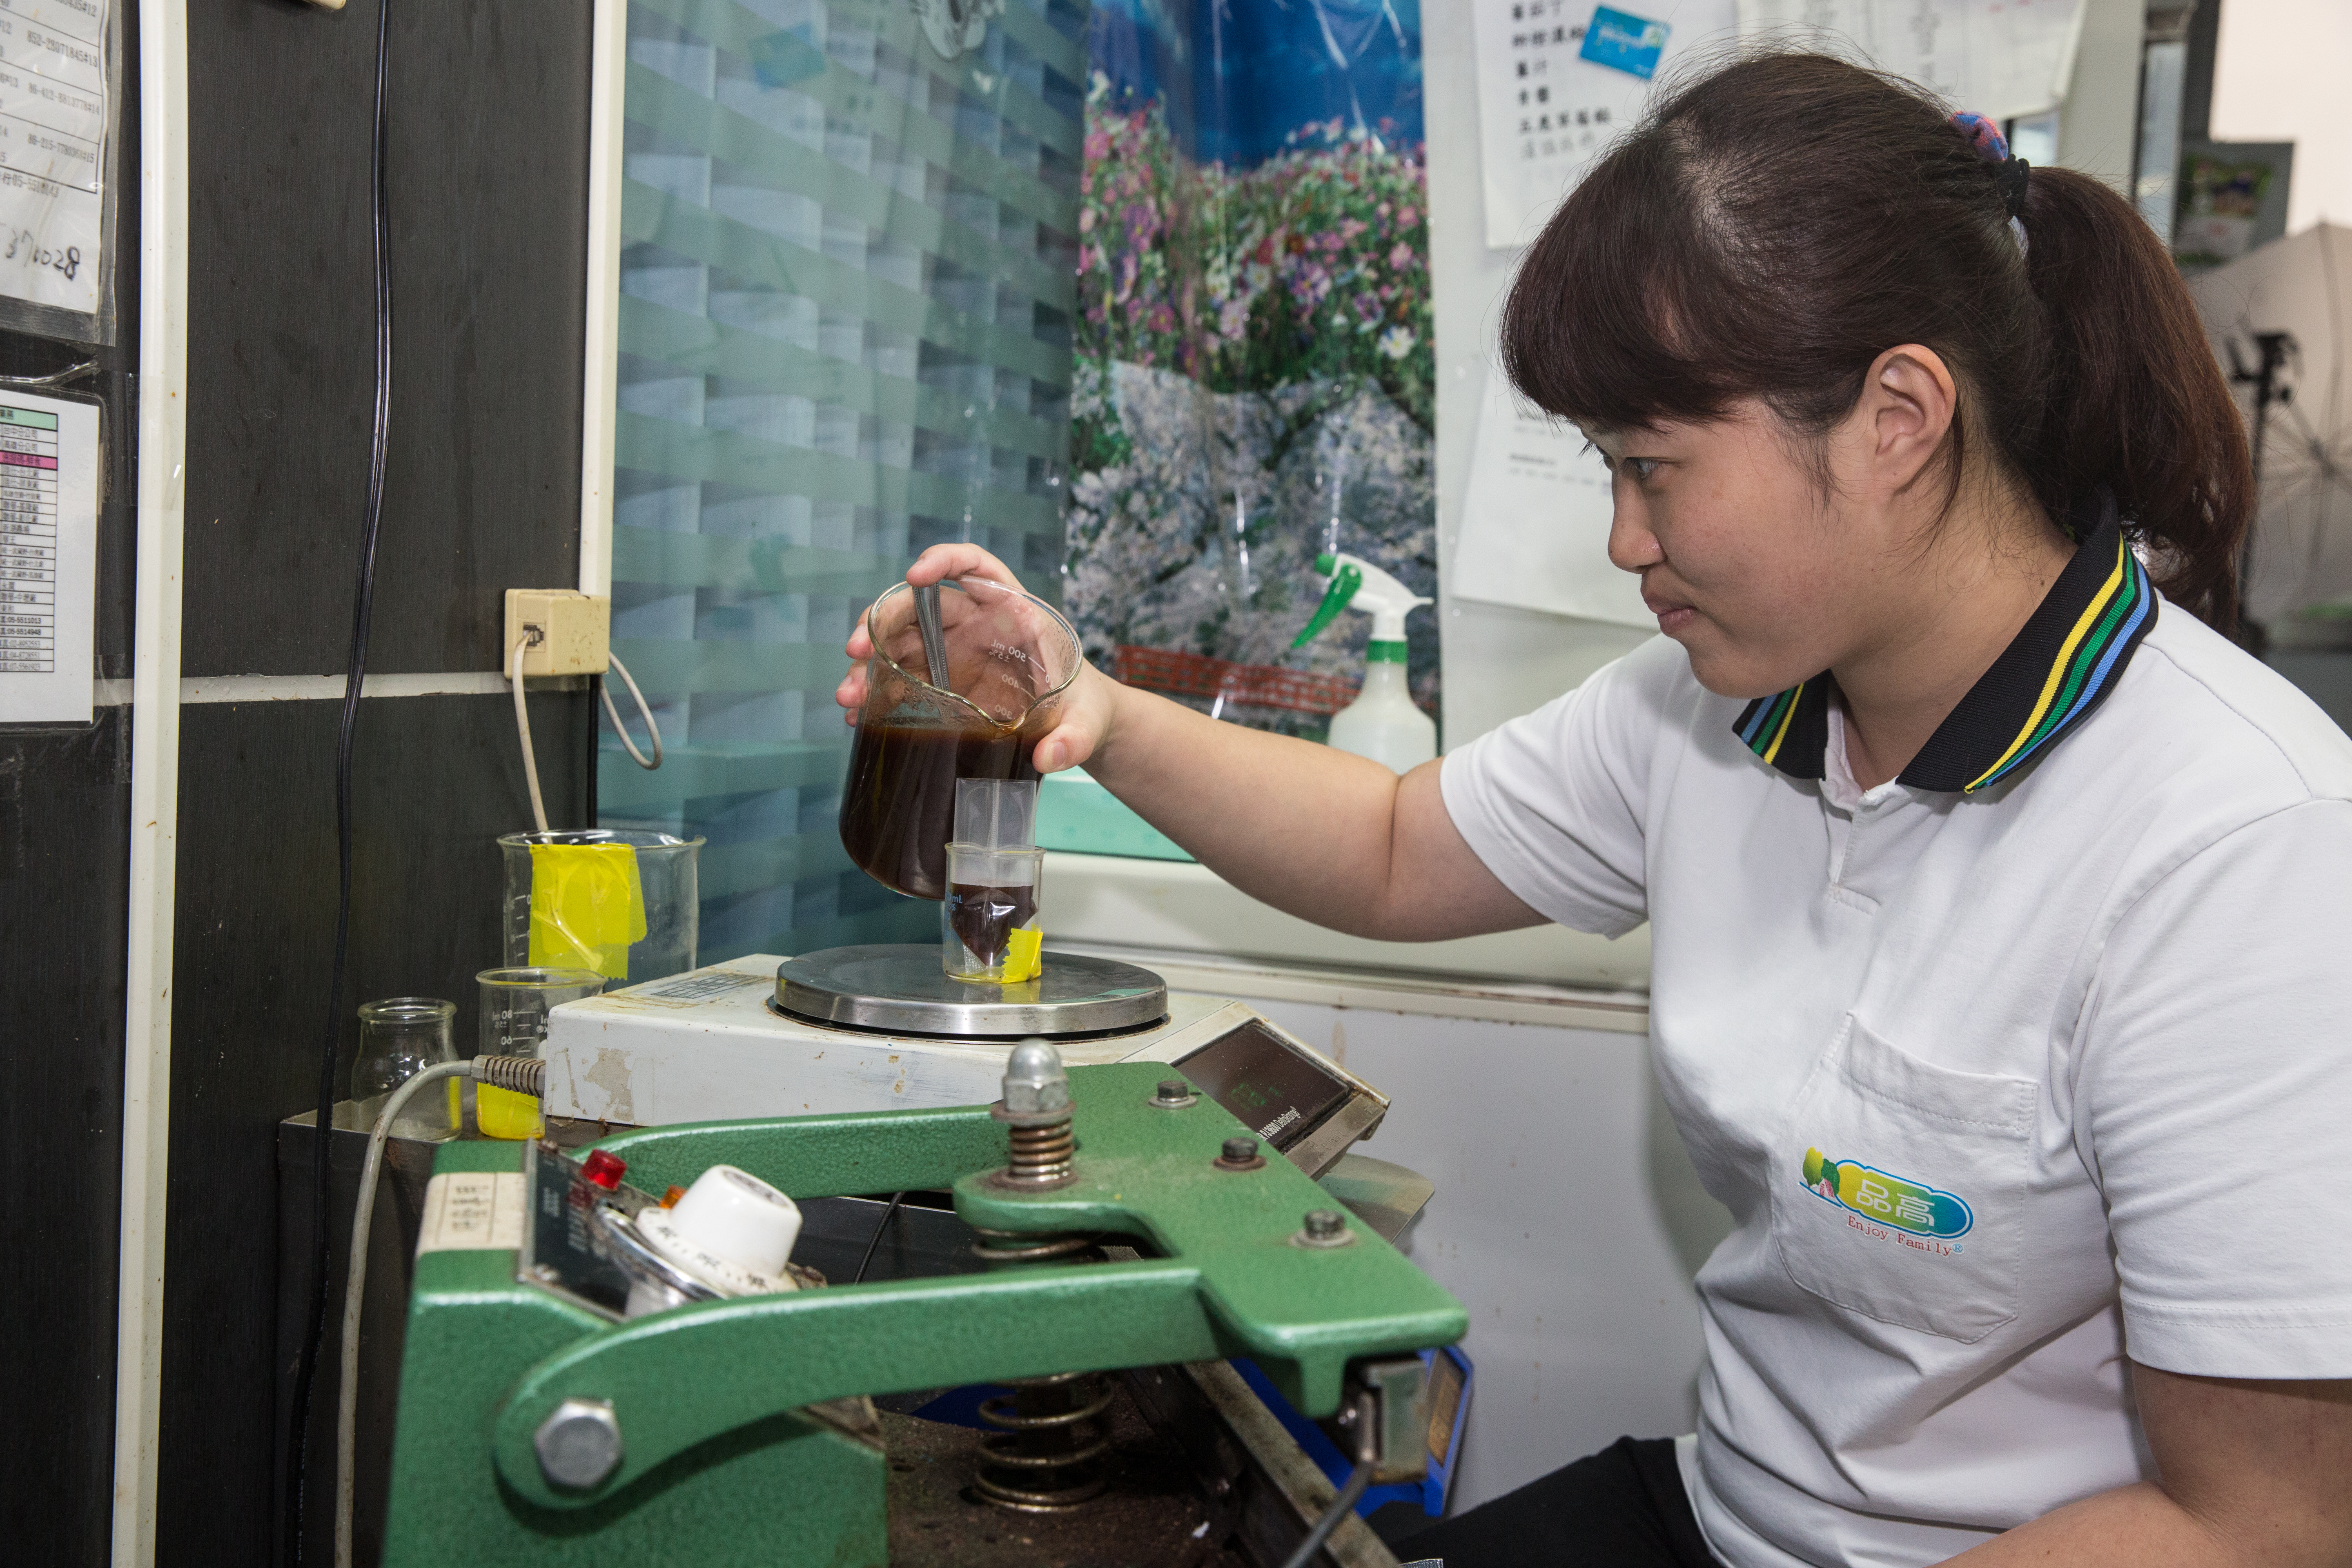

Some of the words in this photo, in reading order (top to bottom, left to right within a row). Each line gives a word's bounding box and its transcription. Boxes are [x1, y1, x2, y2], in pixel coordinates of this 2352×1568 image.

[952, 894, 963, 904] mL
[1259, 1122, 1282, 1138] PJ3600
[1848, 1216, 1889, 1241] Enjoy
